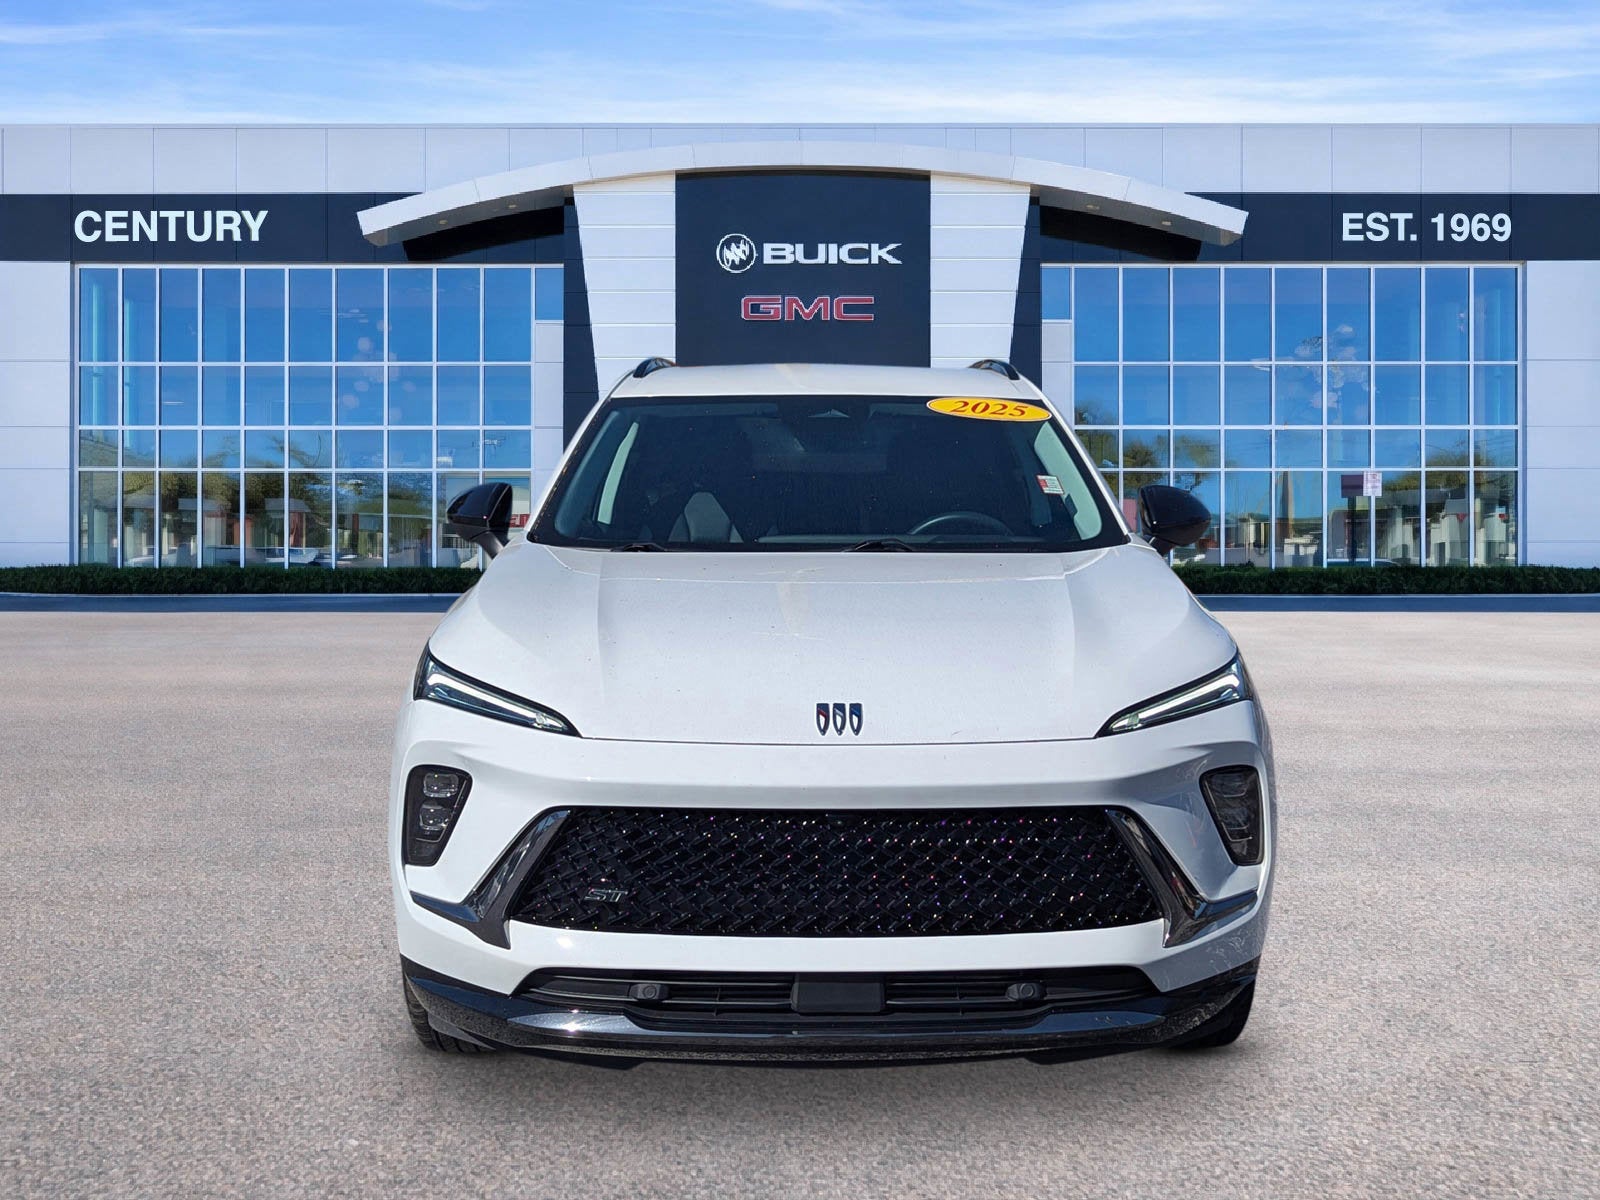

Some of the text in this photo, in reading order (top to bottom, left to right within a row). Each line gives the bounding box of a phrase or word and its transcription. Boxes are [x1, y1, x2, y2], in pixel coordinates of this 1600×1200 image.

[74, 210, 269, 243] CENTURY
[1341, 212, 1512, 242] EST. 1969
[762, 242, 903, 266] BUICK
[740, 294, 875, 321] GMC
[950, 400, 1029, 417] 2025
[584, 889, 628, 902] ST
